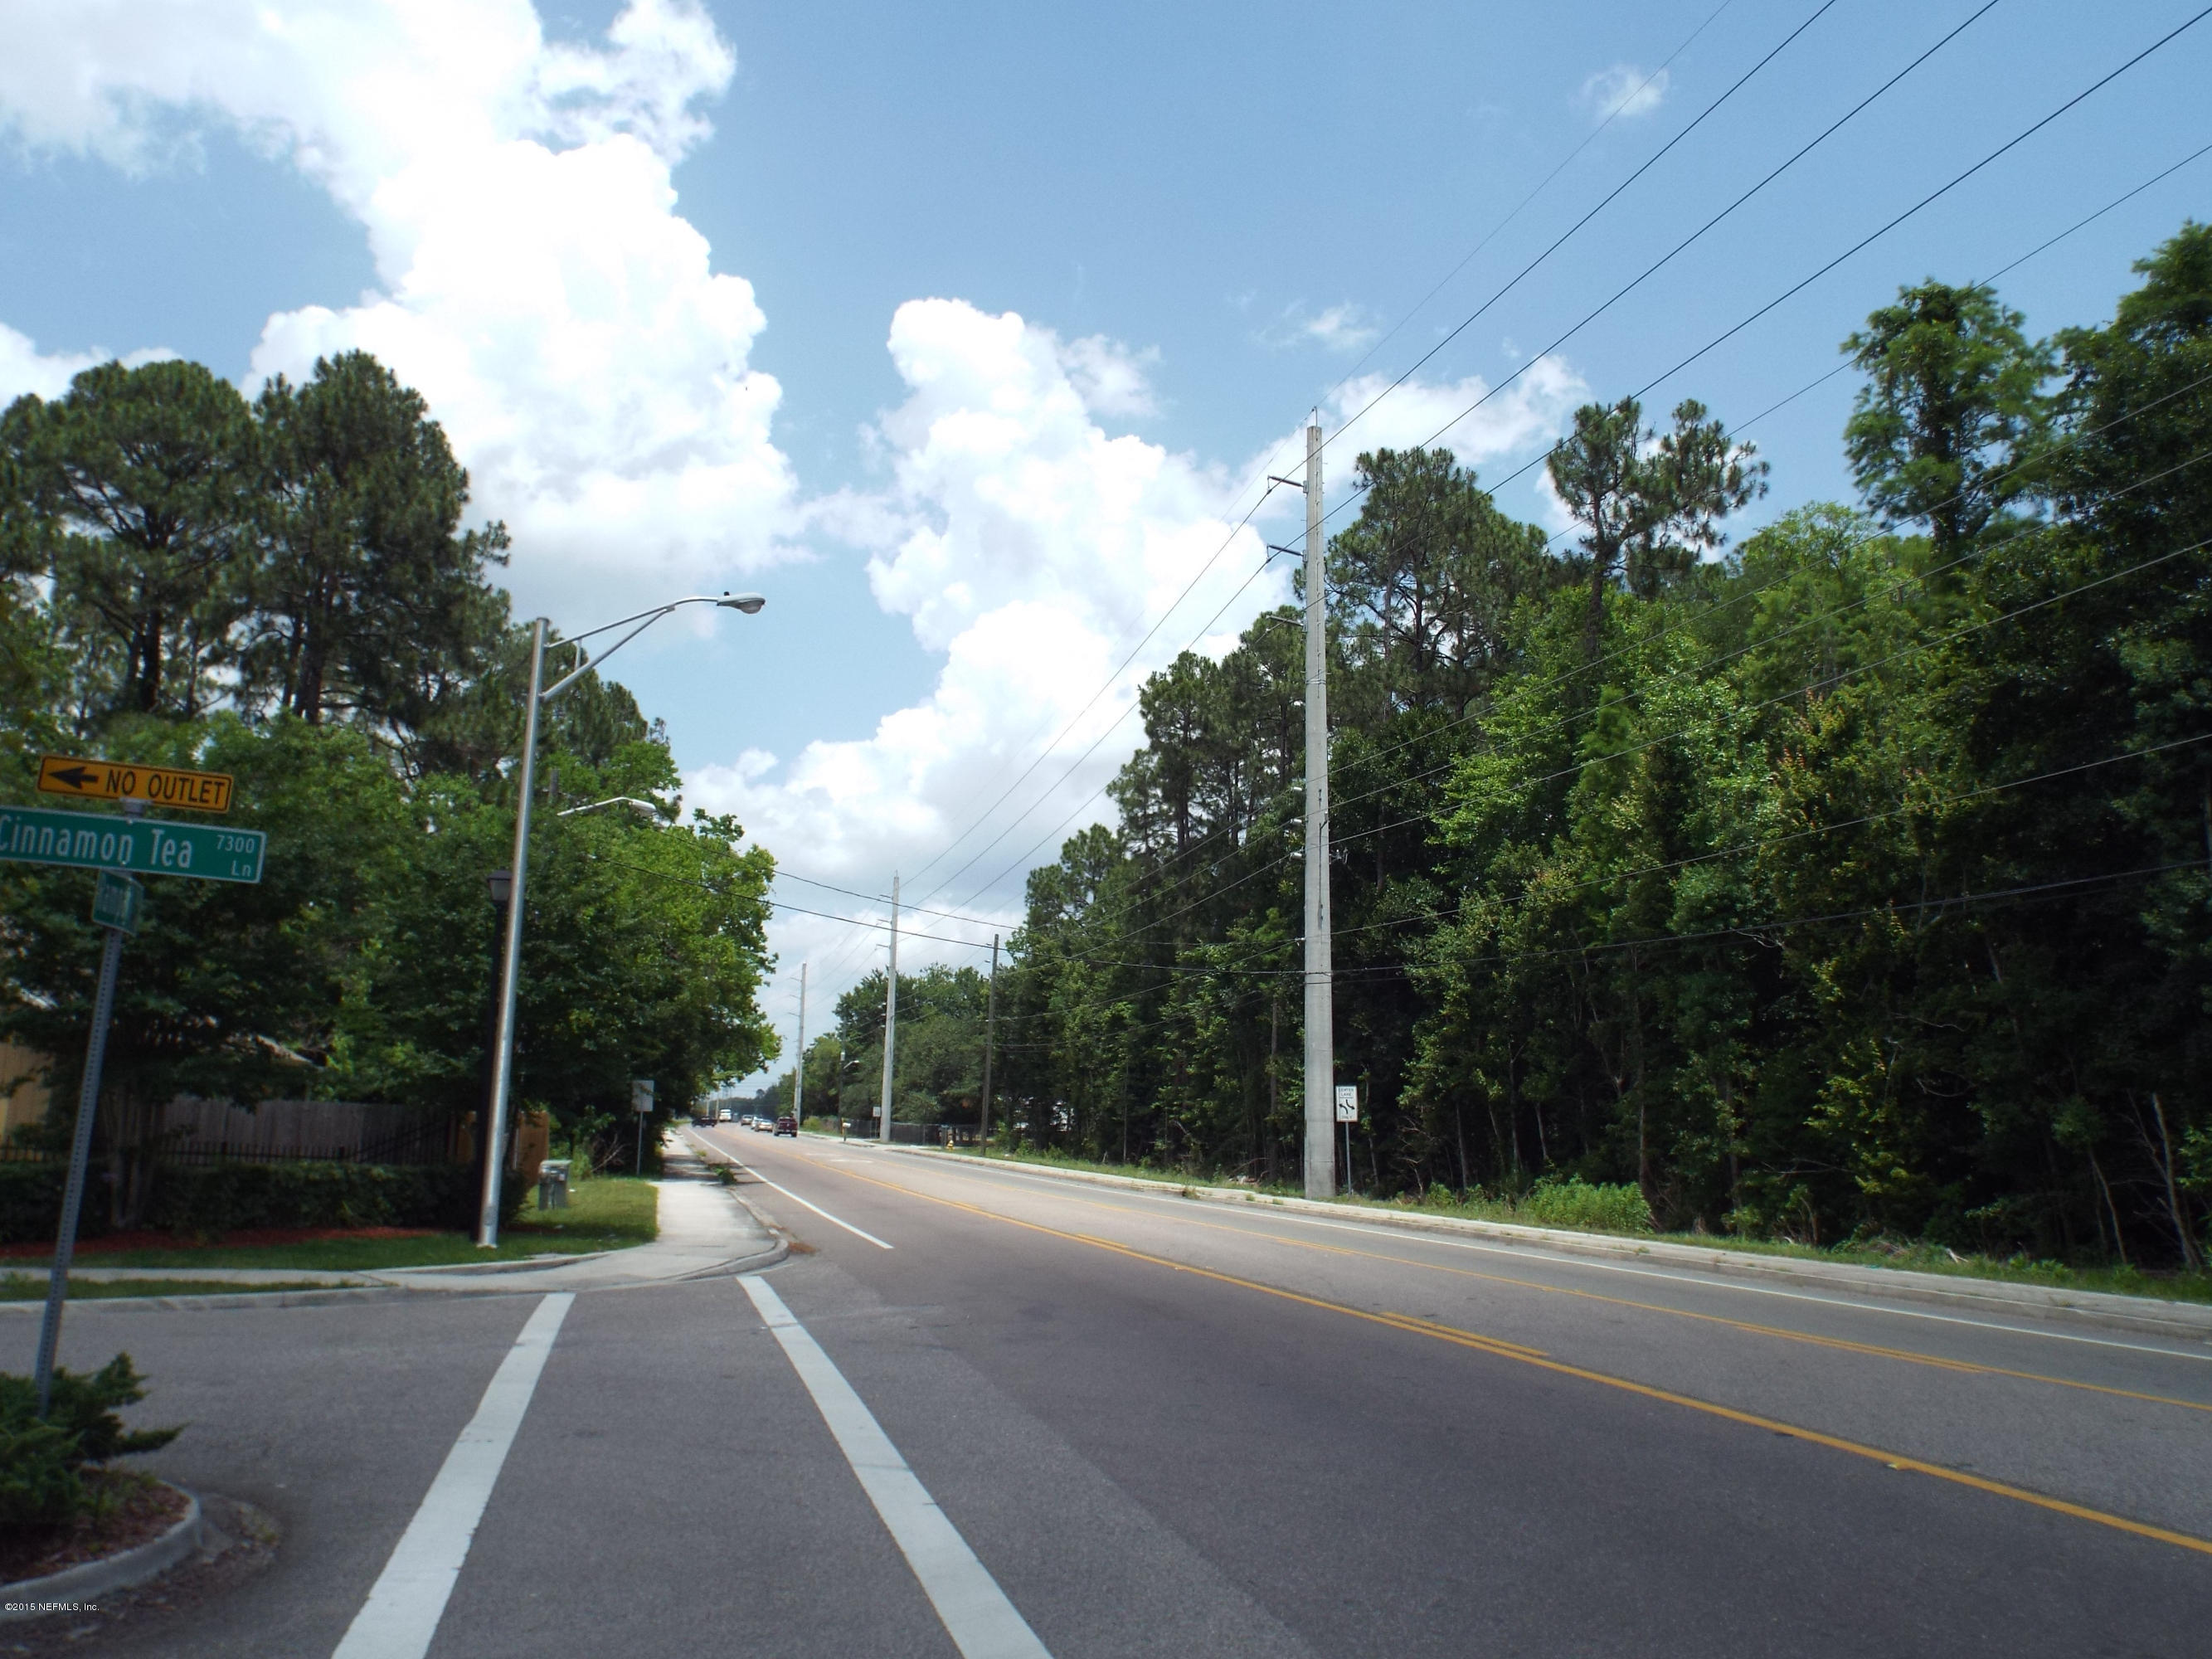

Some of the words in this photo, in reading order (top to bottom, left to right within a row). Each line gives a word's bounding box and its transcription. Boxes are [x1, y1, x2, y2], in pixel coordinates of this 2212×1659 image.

[106, 769, 136, 795] NO
[148, 773, 225, 805] OUTLET
[0, 814, 134, 864] Cinnamon
[151, 829, 192, 868] Tea
[216, 834, 255, 854] 7300
[231, 859, 251, 877] Ln
